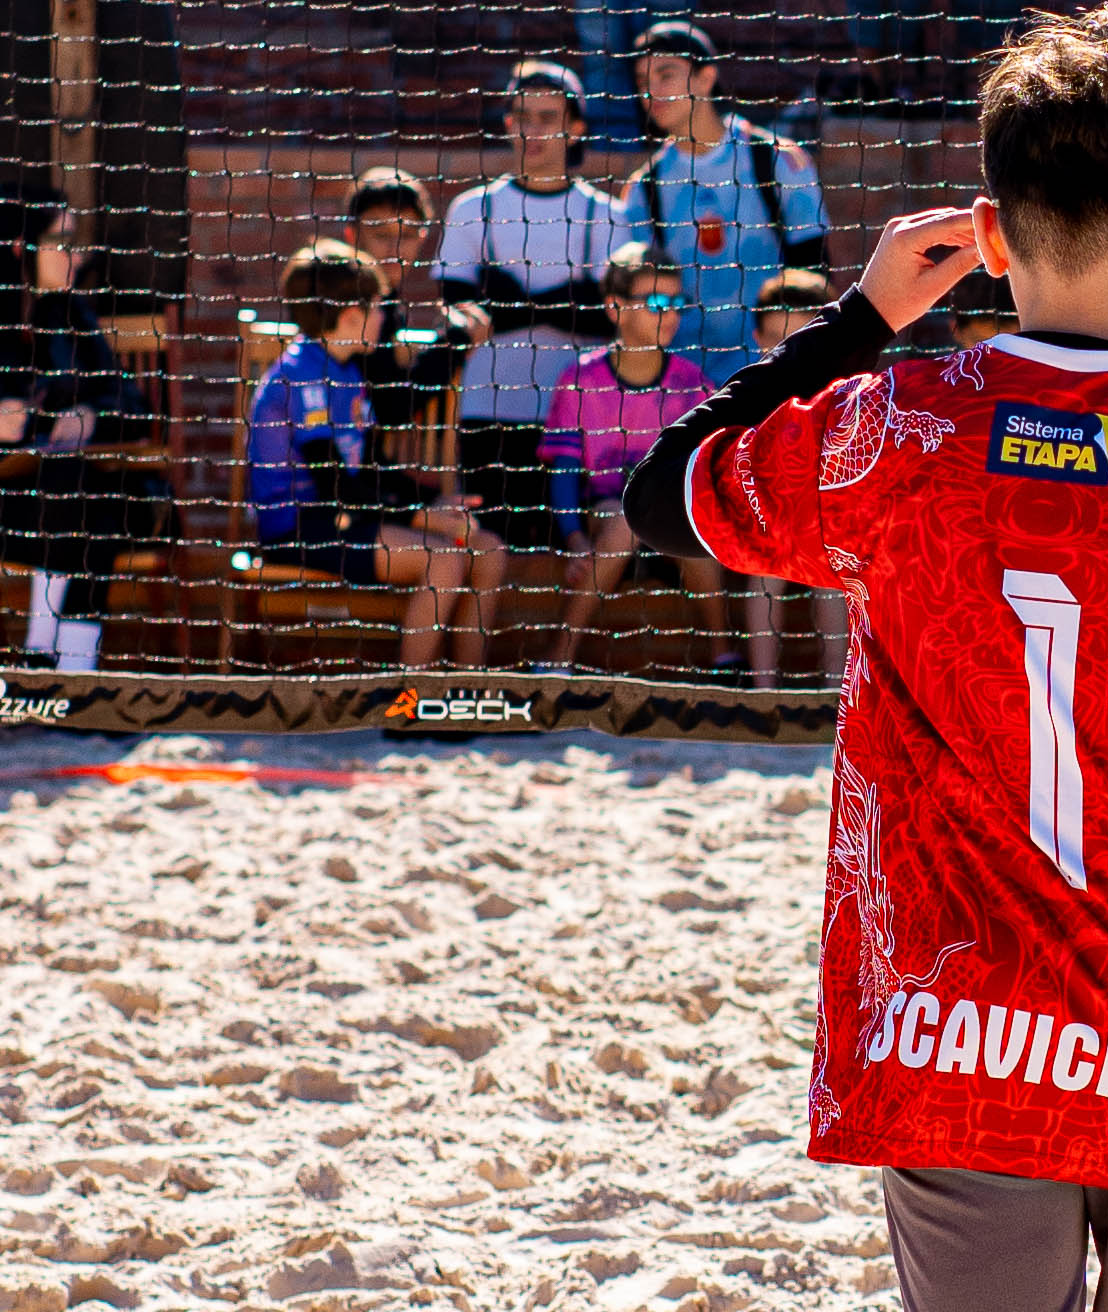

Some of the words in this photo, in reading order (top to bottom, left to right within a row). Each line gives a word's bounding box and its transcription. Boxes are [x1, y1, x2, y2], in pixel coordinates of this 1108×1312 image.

[1006, 415, 1084, 442] Sistema
[1000, 436, 1097, 473] ETAPA
[0, 678, 70, 718] zzure
